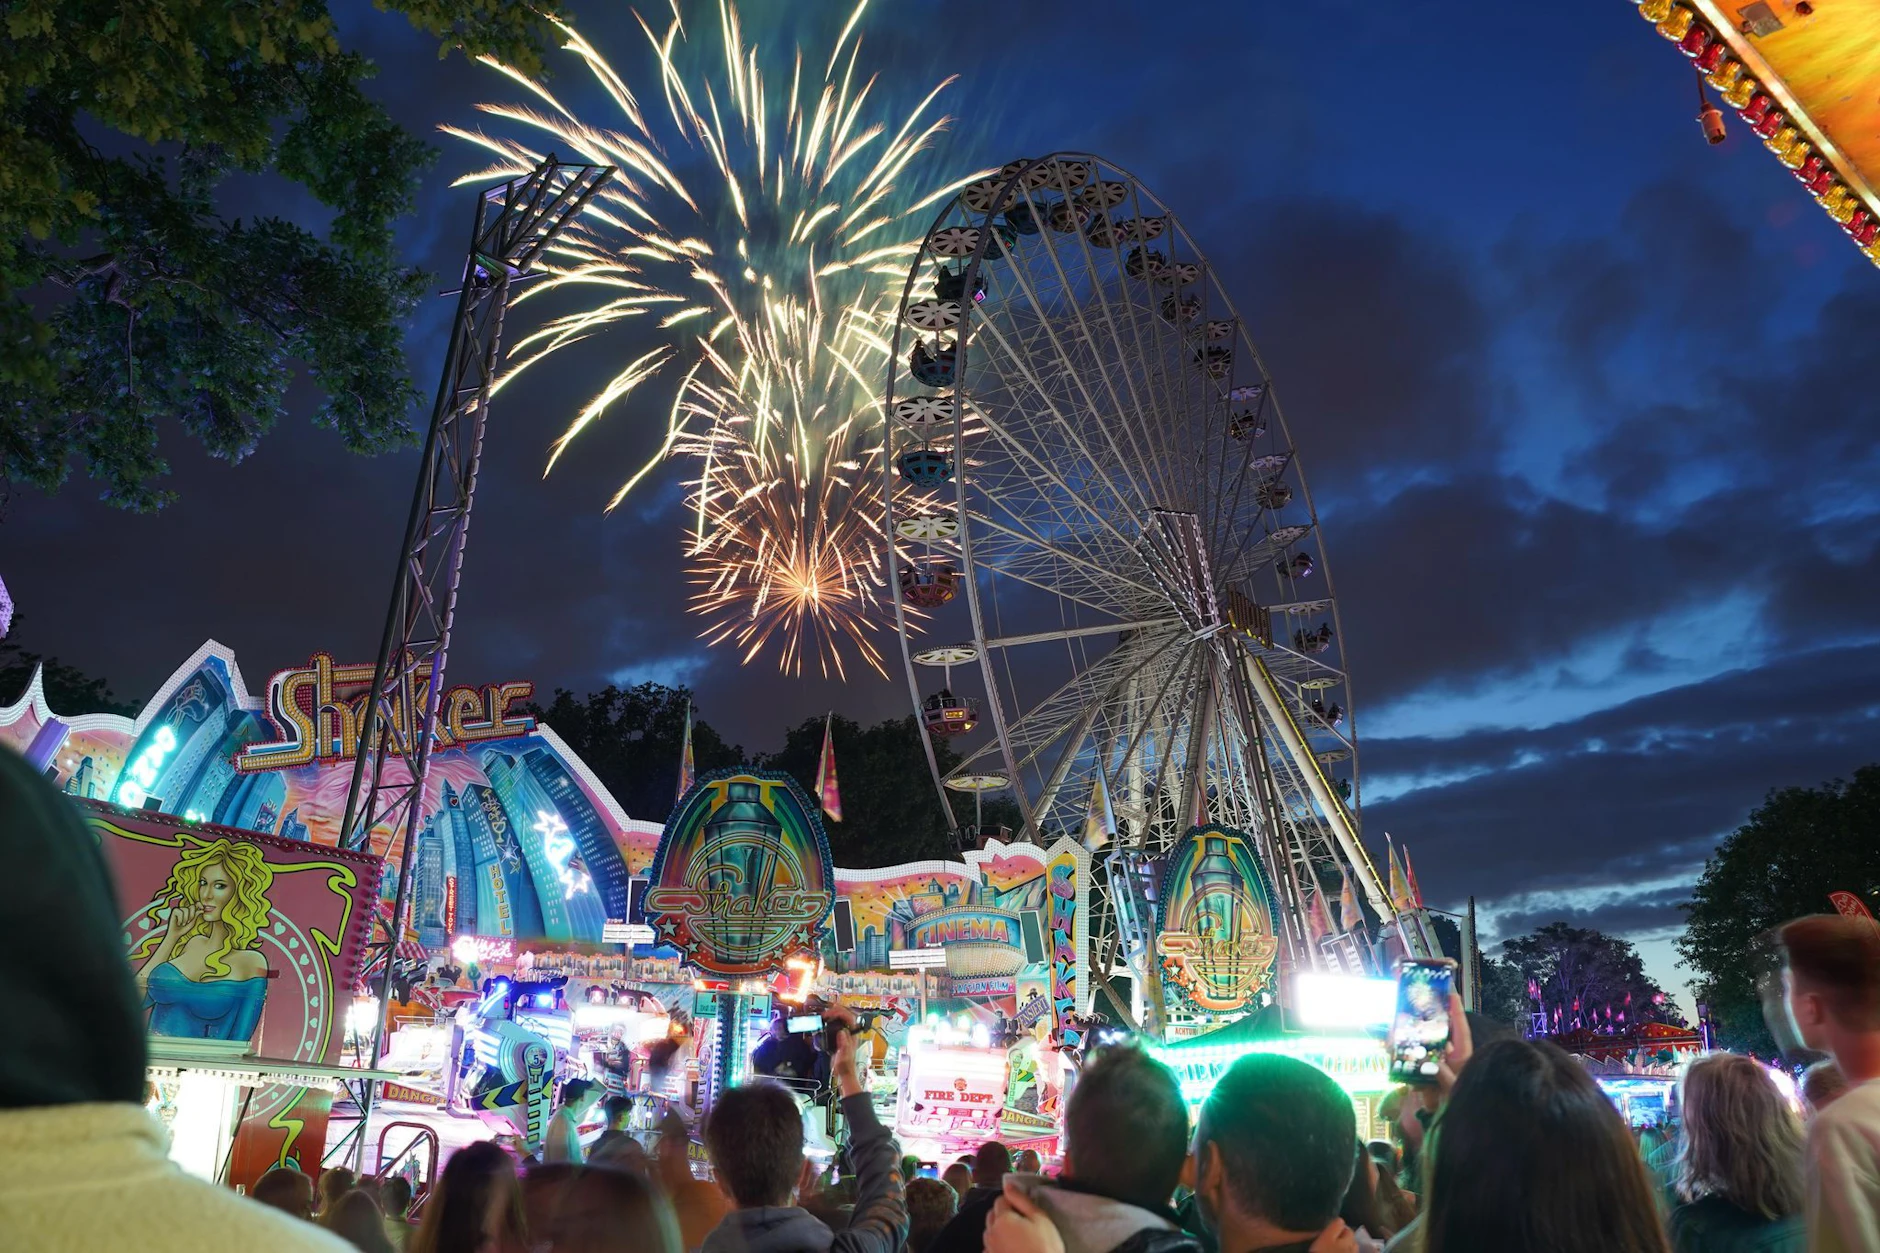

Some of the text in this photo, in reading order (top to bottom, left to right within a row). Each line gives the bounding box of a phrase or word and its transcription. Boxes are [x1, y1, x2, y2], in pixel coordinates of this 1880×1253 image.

[236, 653, 533, 771] Shaker
[489, 865, 512, 936] HOTEL
[662, 854, 820, 918] Shaker
[916, 917, 1009, 948] CINEMA
[1050, 864, 1085, 1046] SHAKER
[957, 982, 987, 994] ACTION
[989, 980, 1010, 992] FILM
[533, 1054, 539, 1065] 5
[924, 1090, 996, 1104] FIRE DEPT.
